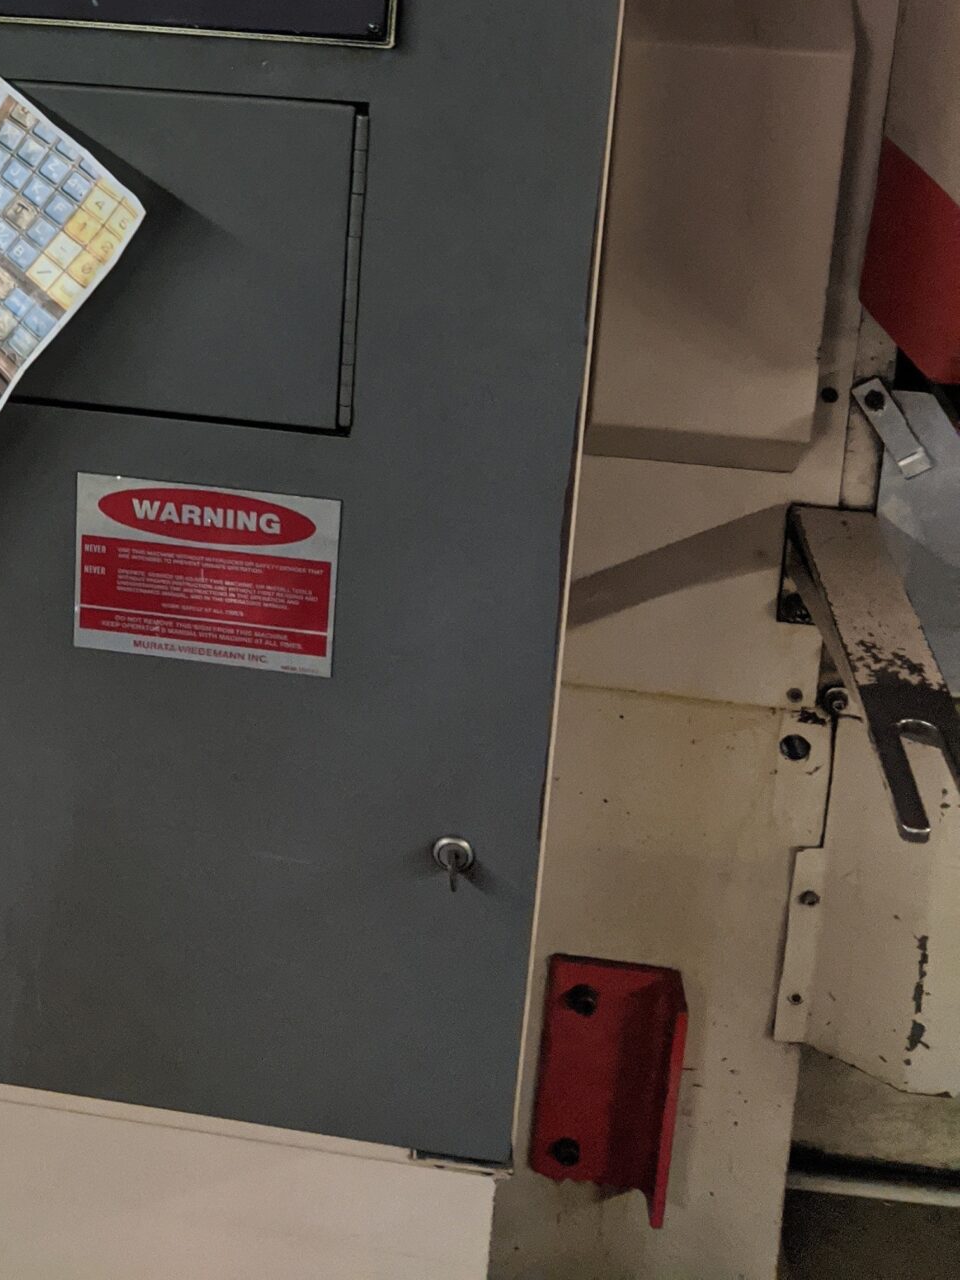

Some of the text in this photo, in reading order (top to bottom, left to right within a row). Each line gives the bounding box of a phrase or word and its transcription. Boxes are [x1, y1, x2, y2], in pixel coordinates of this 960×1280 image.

[132, 498, 281, 535] WARNING
[84, 544, 107, 554] NEVER
[83, 565, 106, 575] NEVER
[133, 639, 175, 651] MURATA
